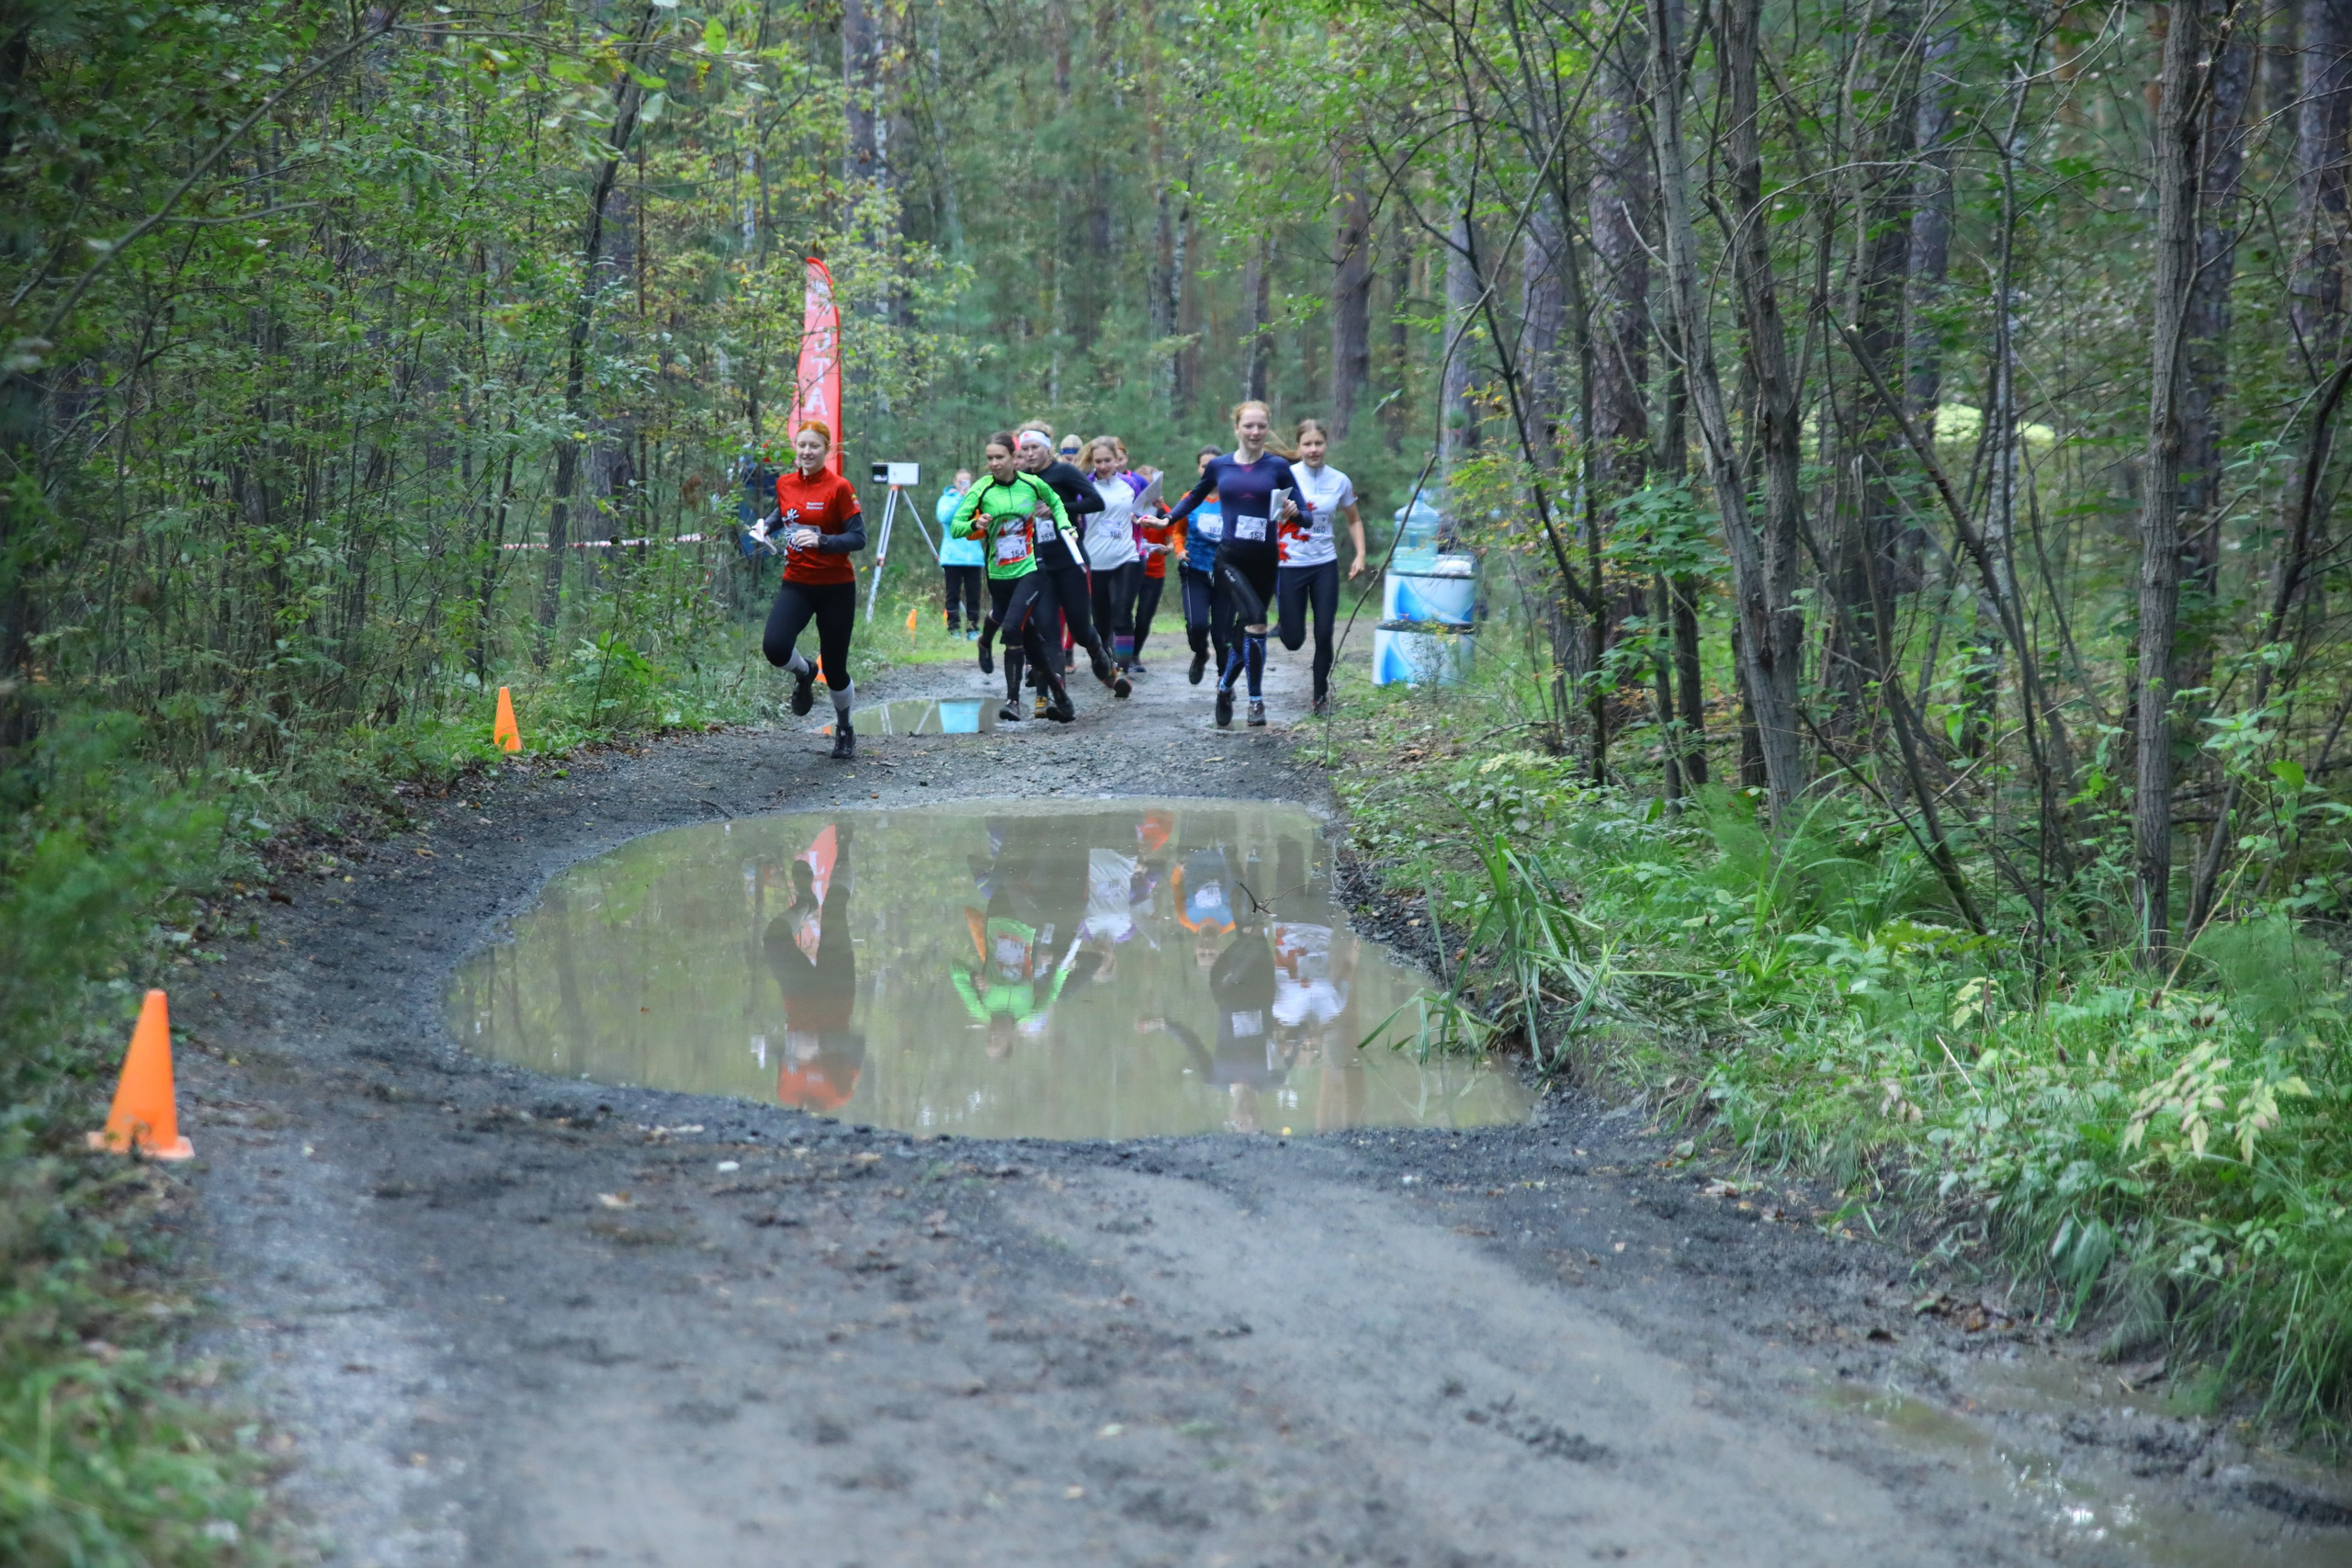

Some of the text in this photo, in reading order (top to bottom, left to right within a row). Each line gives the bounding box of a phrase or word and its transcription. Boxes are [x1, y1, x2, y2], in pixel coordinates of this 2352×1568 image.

[1313, 525, 1326, 534] 160
[1041, 533, 1055, 541] 159
[1250, 532, 1265, 540] 152
[1011, 549, 1025, 558] 154
